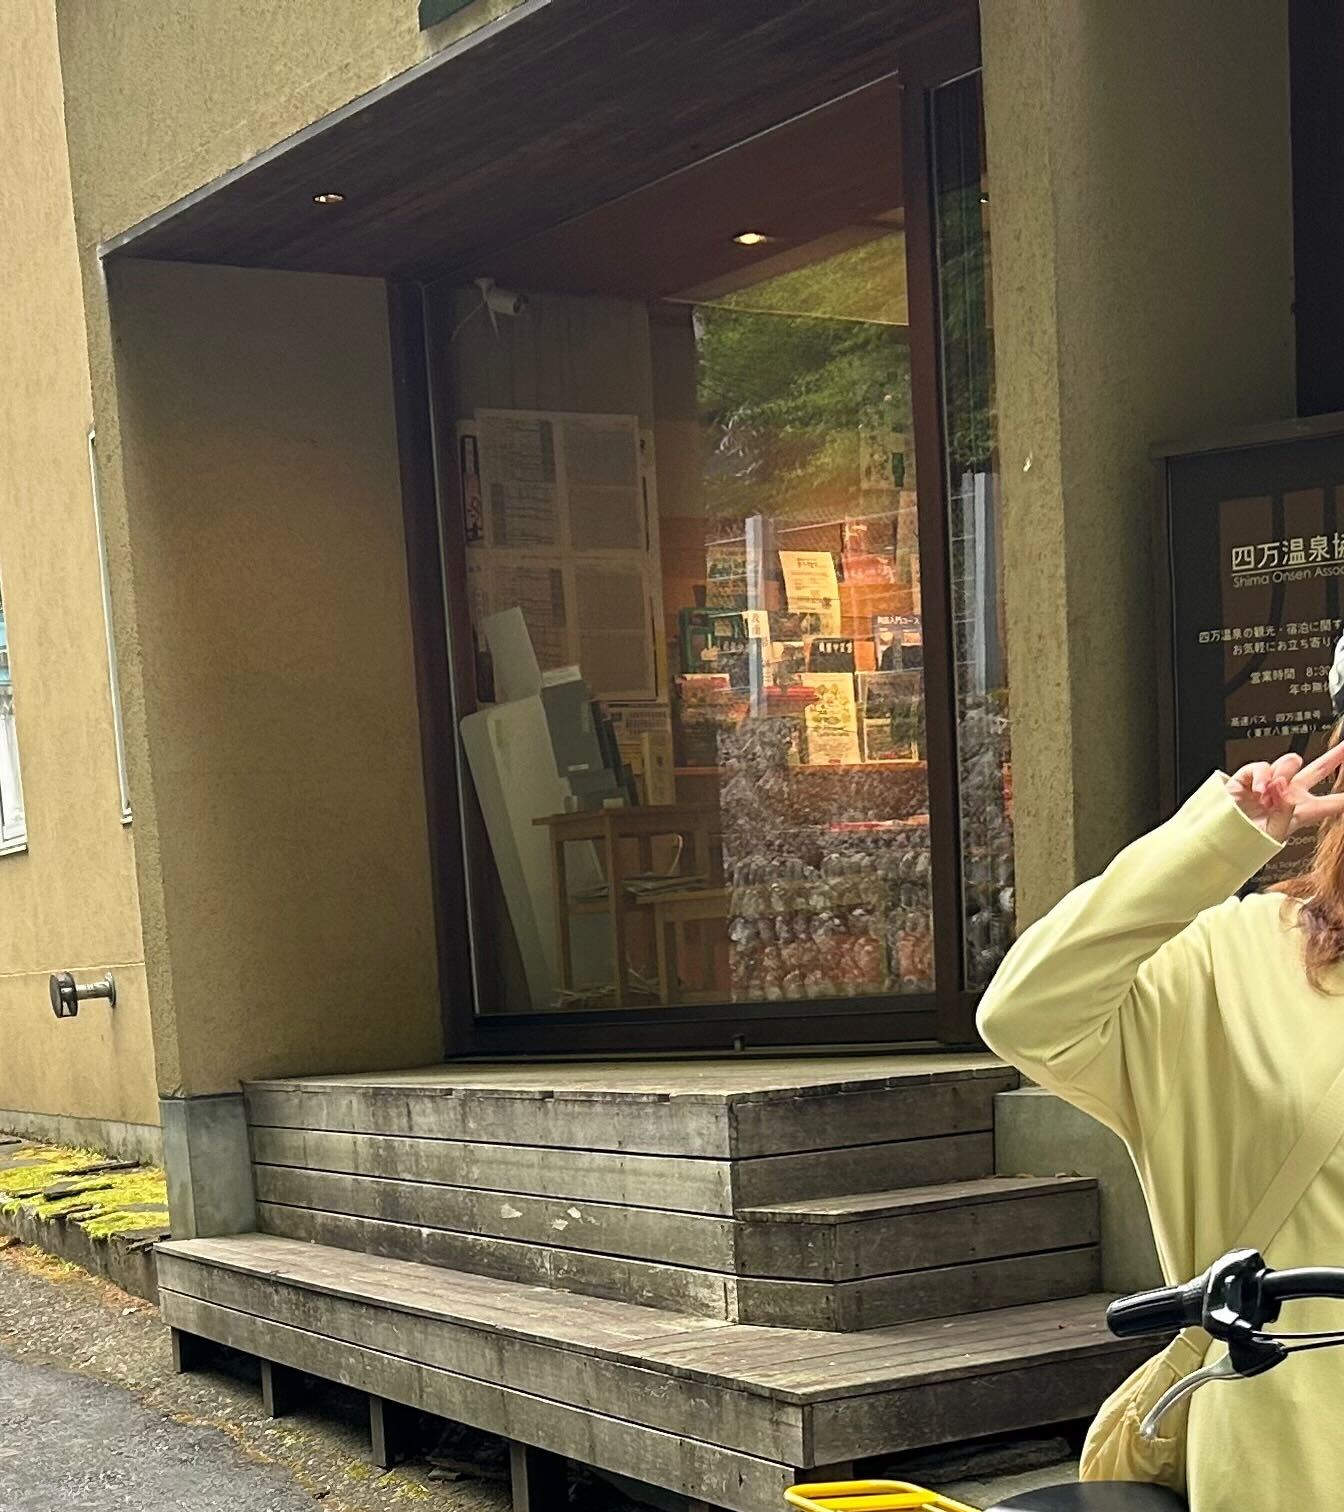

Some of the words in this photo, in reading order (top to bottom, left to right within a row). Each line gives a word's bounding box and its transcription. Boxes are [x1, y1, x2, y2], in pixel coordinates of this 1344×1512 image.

[1233, 574, 1270, 588] Shima
[1272, 566, 1312, 584] Onsen
[1232, 635, 1339, 656] お気軽にお立ち寄り
